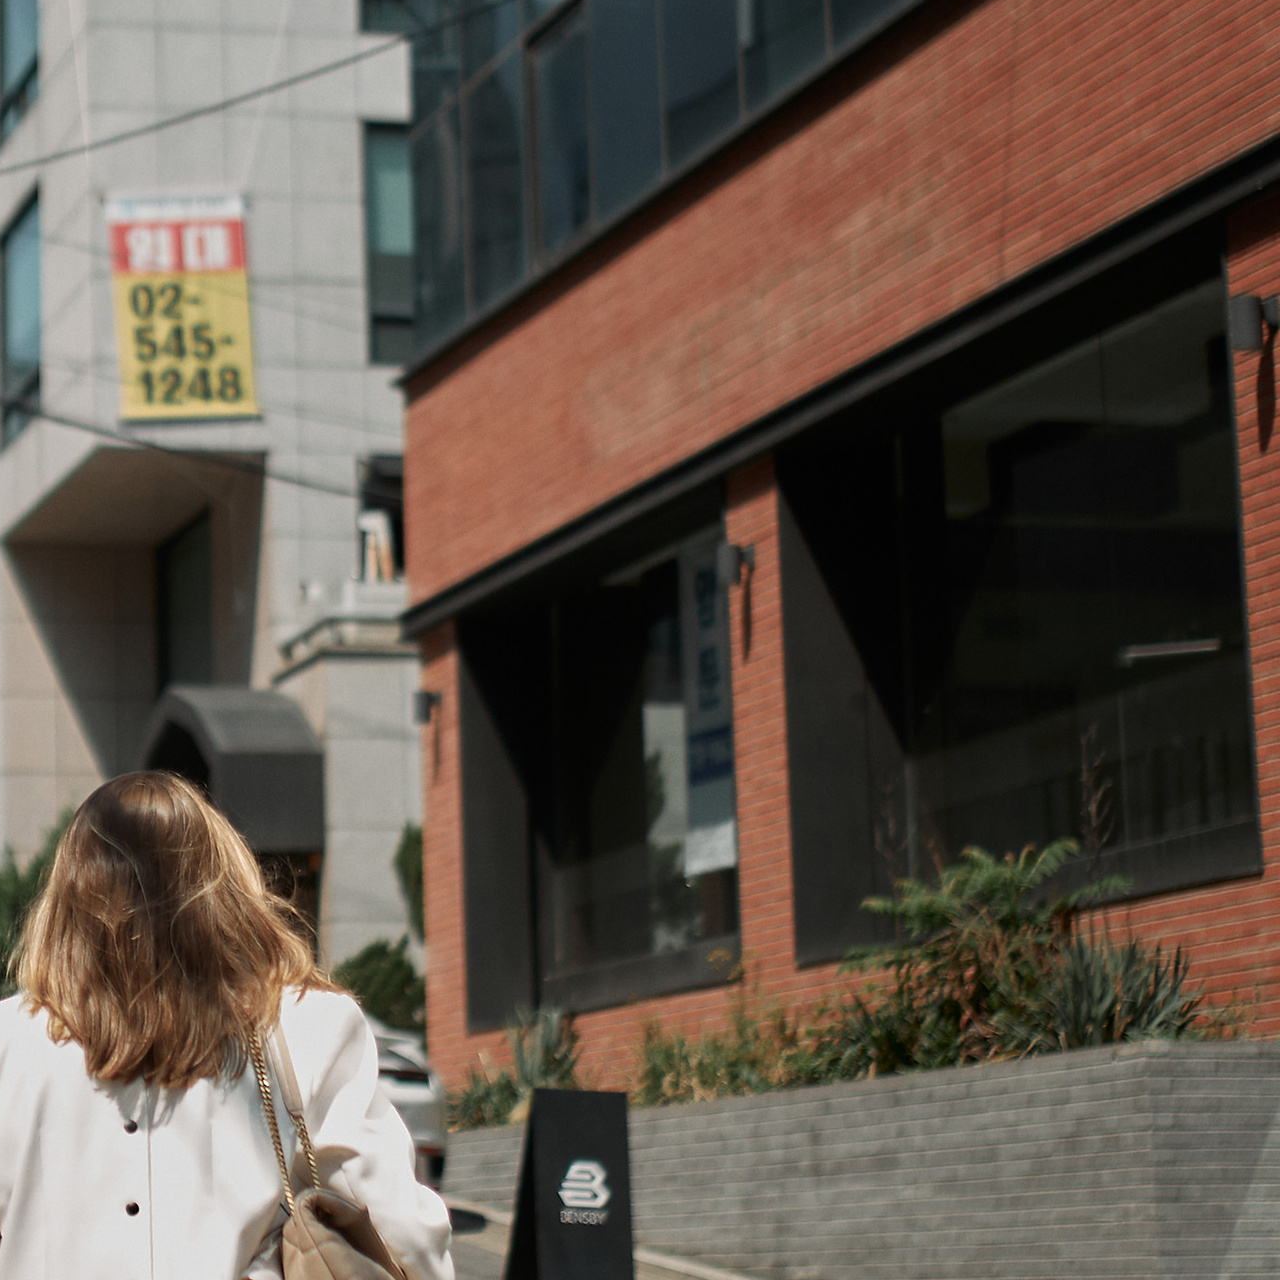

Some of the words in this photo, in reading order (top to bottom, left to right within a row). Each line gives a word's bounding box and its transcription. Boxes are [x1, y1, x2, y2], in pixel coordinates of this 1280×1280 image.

[130, 284, 202, 319] 02-
[134, 322, 234, 363] 545-
[139, 367, 243, 405] 1248
[560, 1210, 606, 1225] BENSBY
